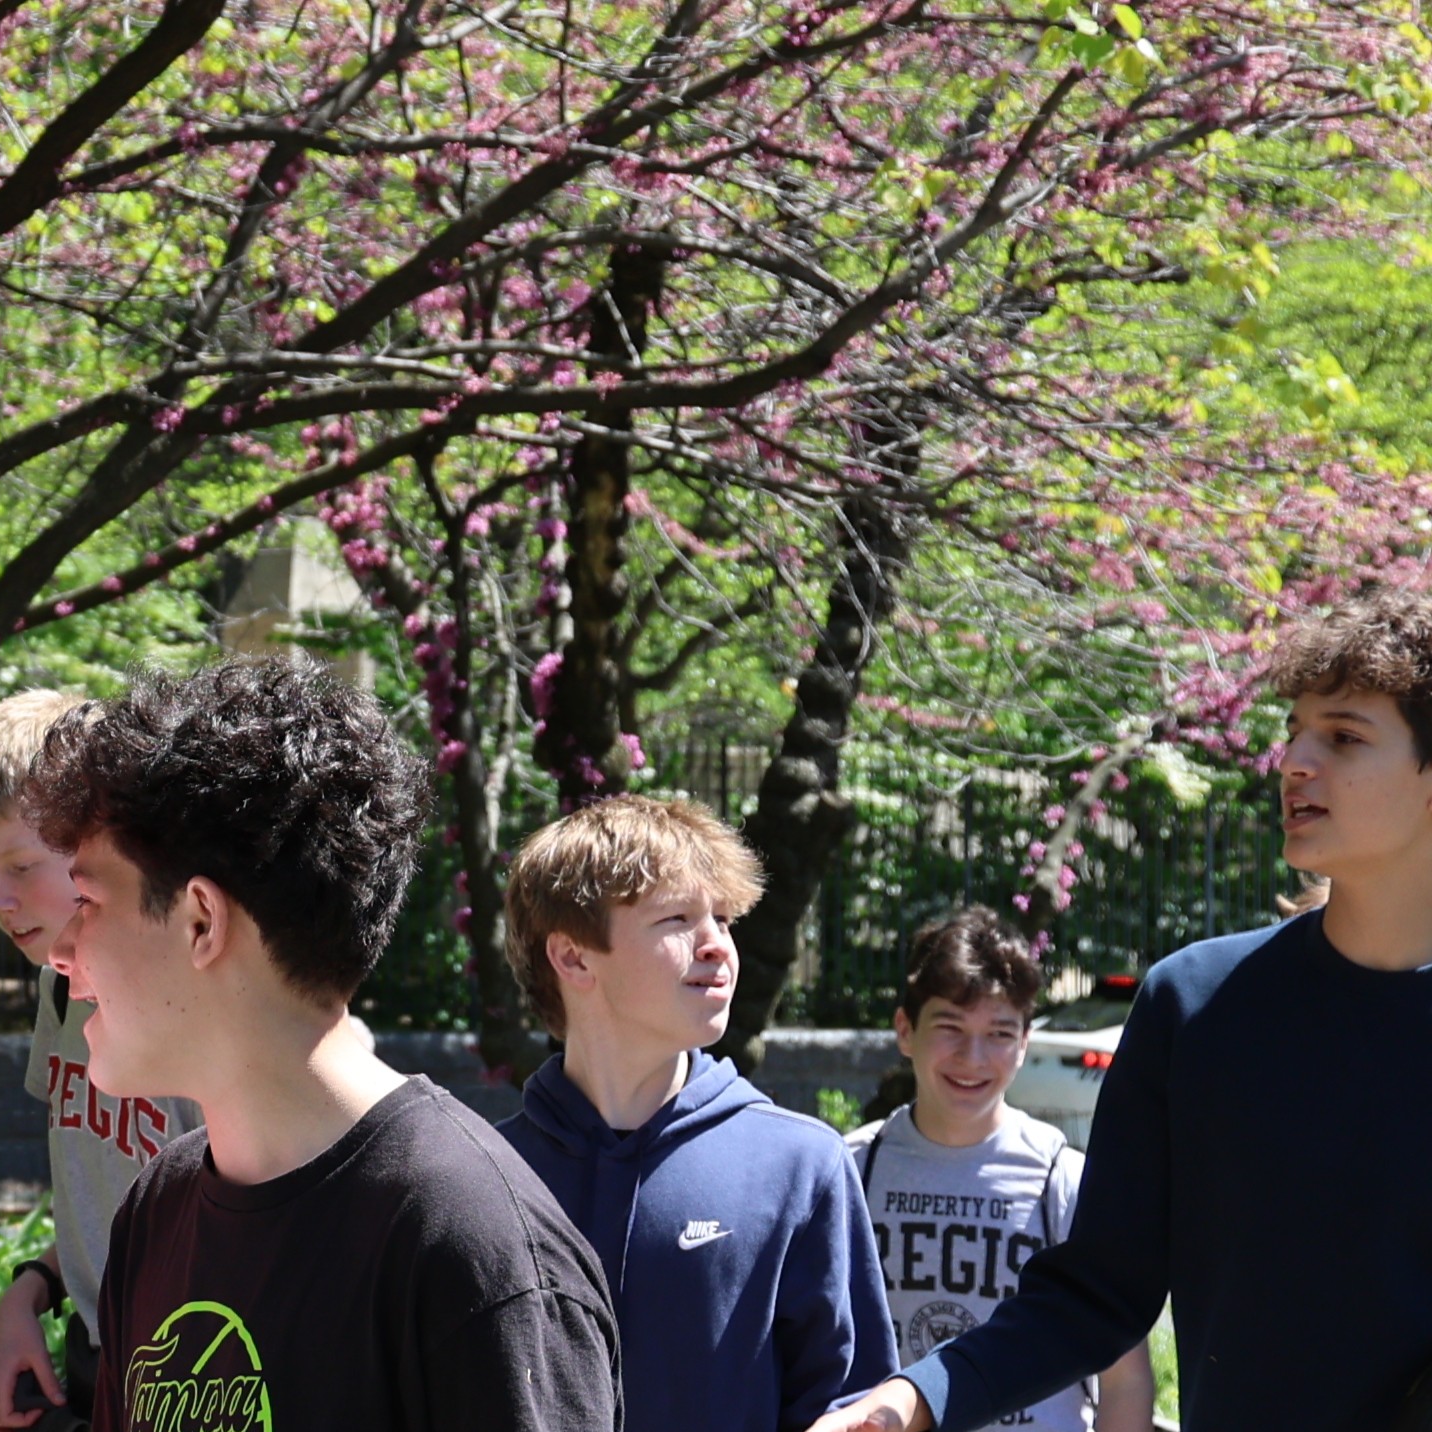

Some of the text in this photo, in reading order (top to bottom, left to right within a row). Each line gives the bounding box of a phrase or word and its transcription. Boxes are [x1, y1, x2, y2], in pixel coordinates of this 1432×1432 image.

[885, 1192, 1012, 1219] PROPERTY OF
[686, 1220, 720, 1239] NIKE
